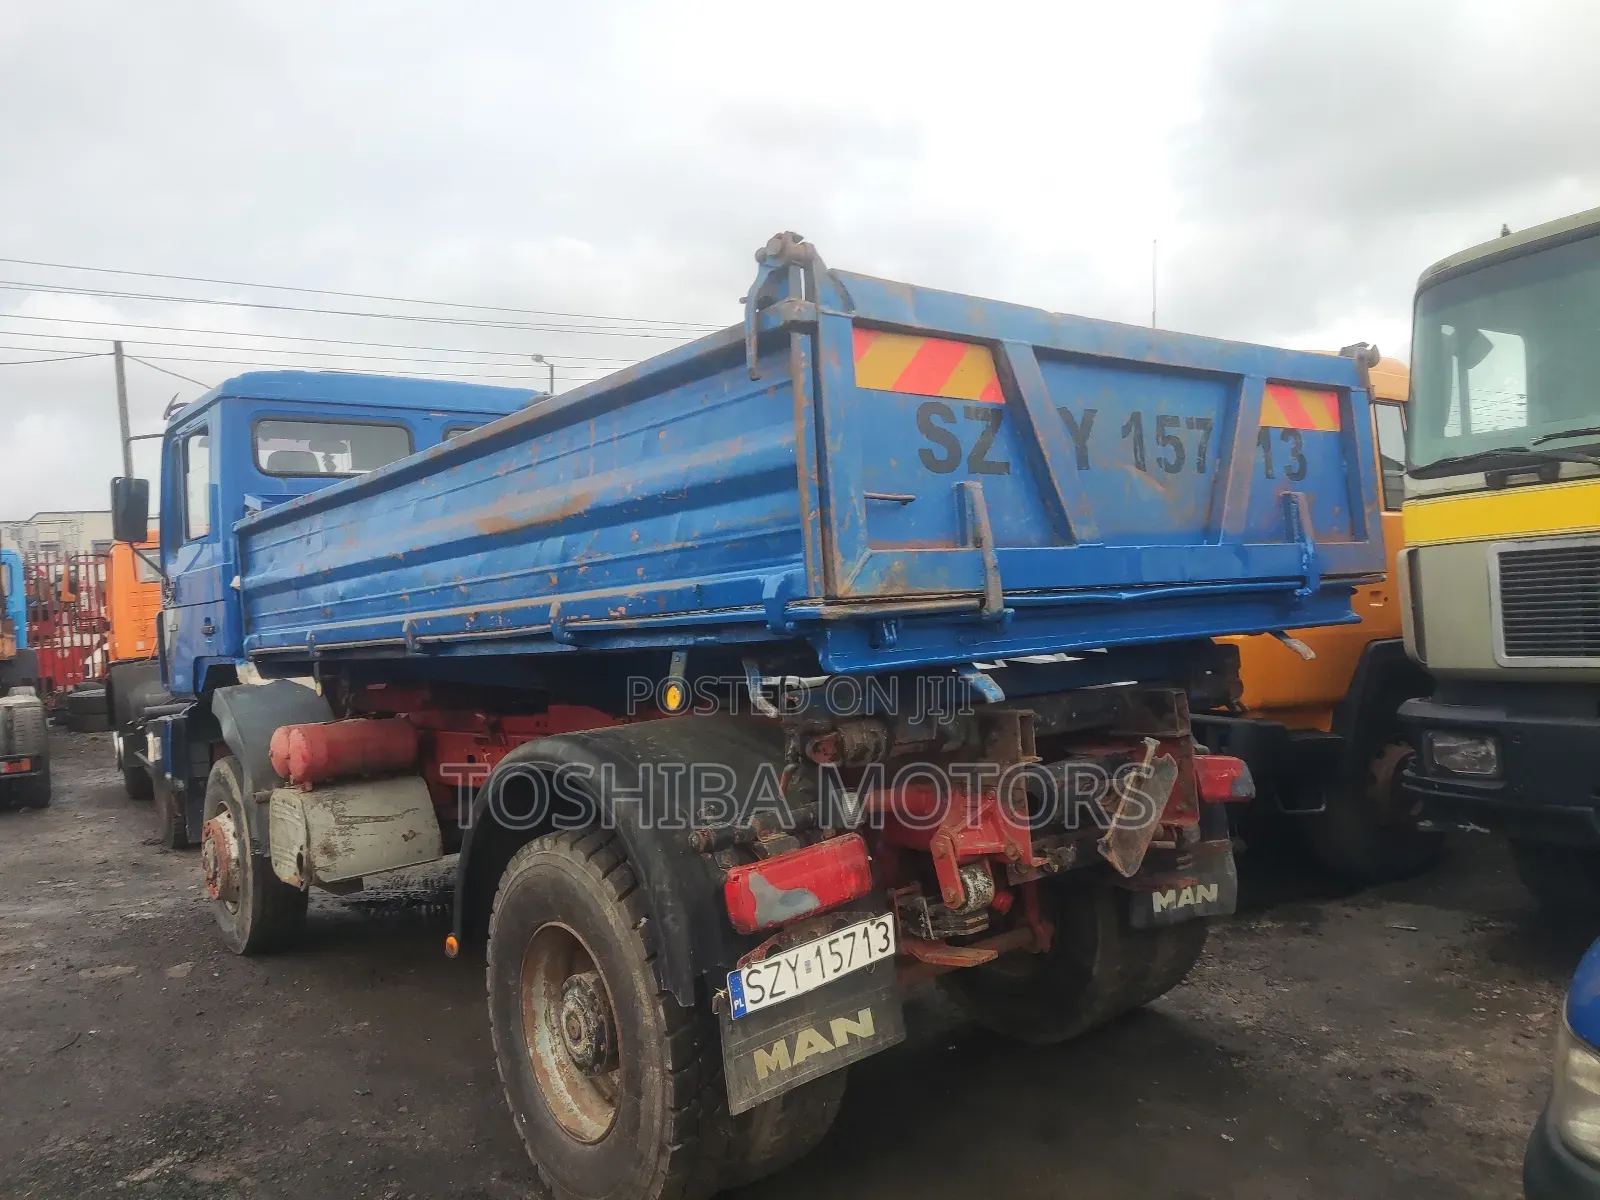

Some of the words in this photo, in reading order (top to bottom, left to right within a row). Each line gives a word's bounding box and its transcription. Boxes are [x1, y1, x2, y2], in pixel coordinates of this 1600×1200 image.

[1152, 883, 1218, 912] MAN
[745, 953, 799, 1004] SZY
[814, 921, 891, 979] 15713
[733, 998, 745, 1010] PL
[753, 1007, 876, 1080] MAN
